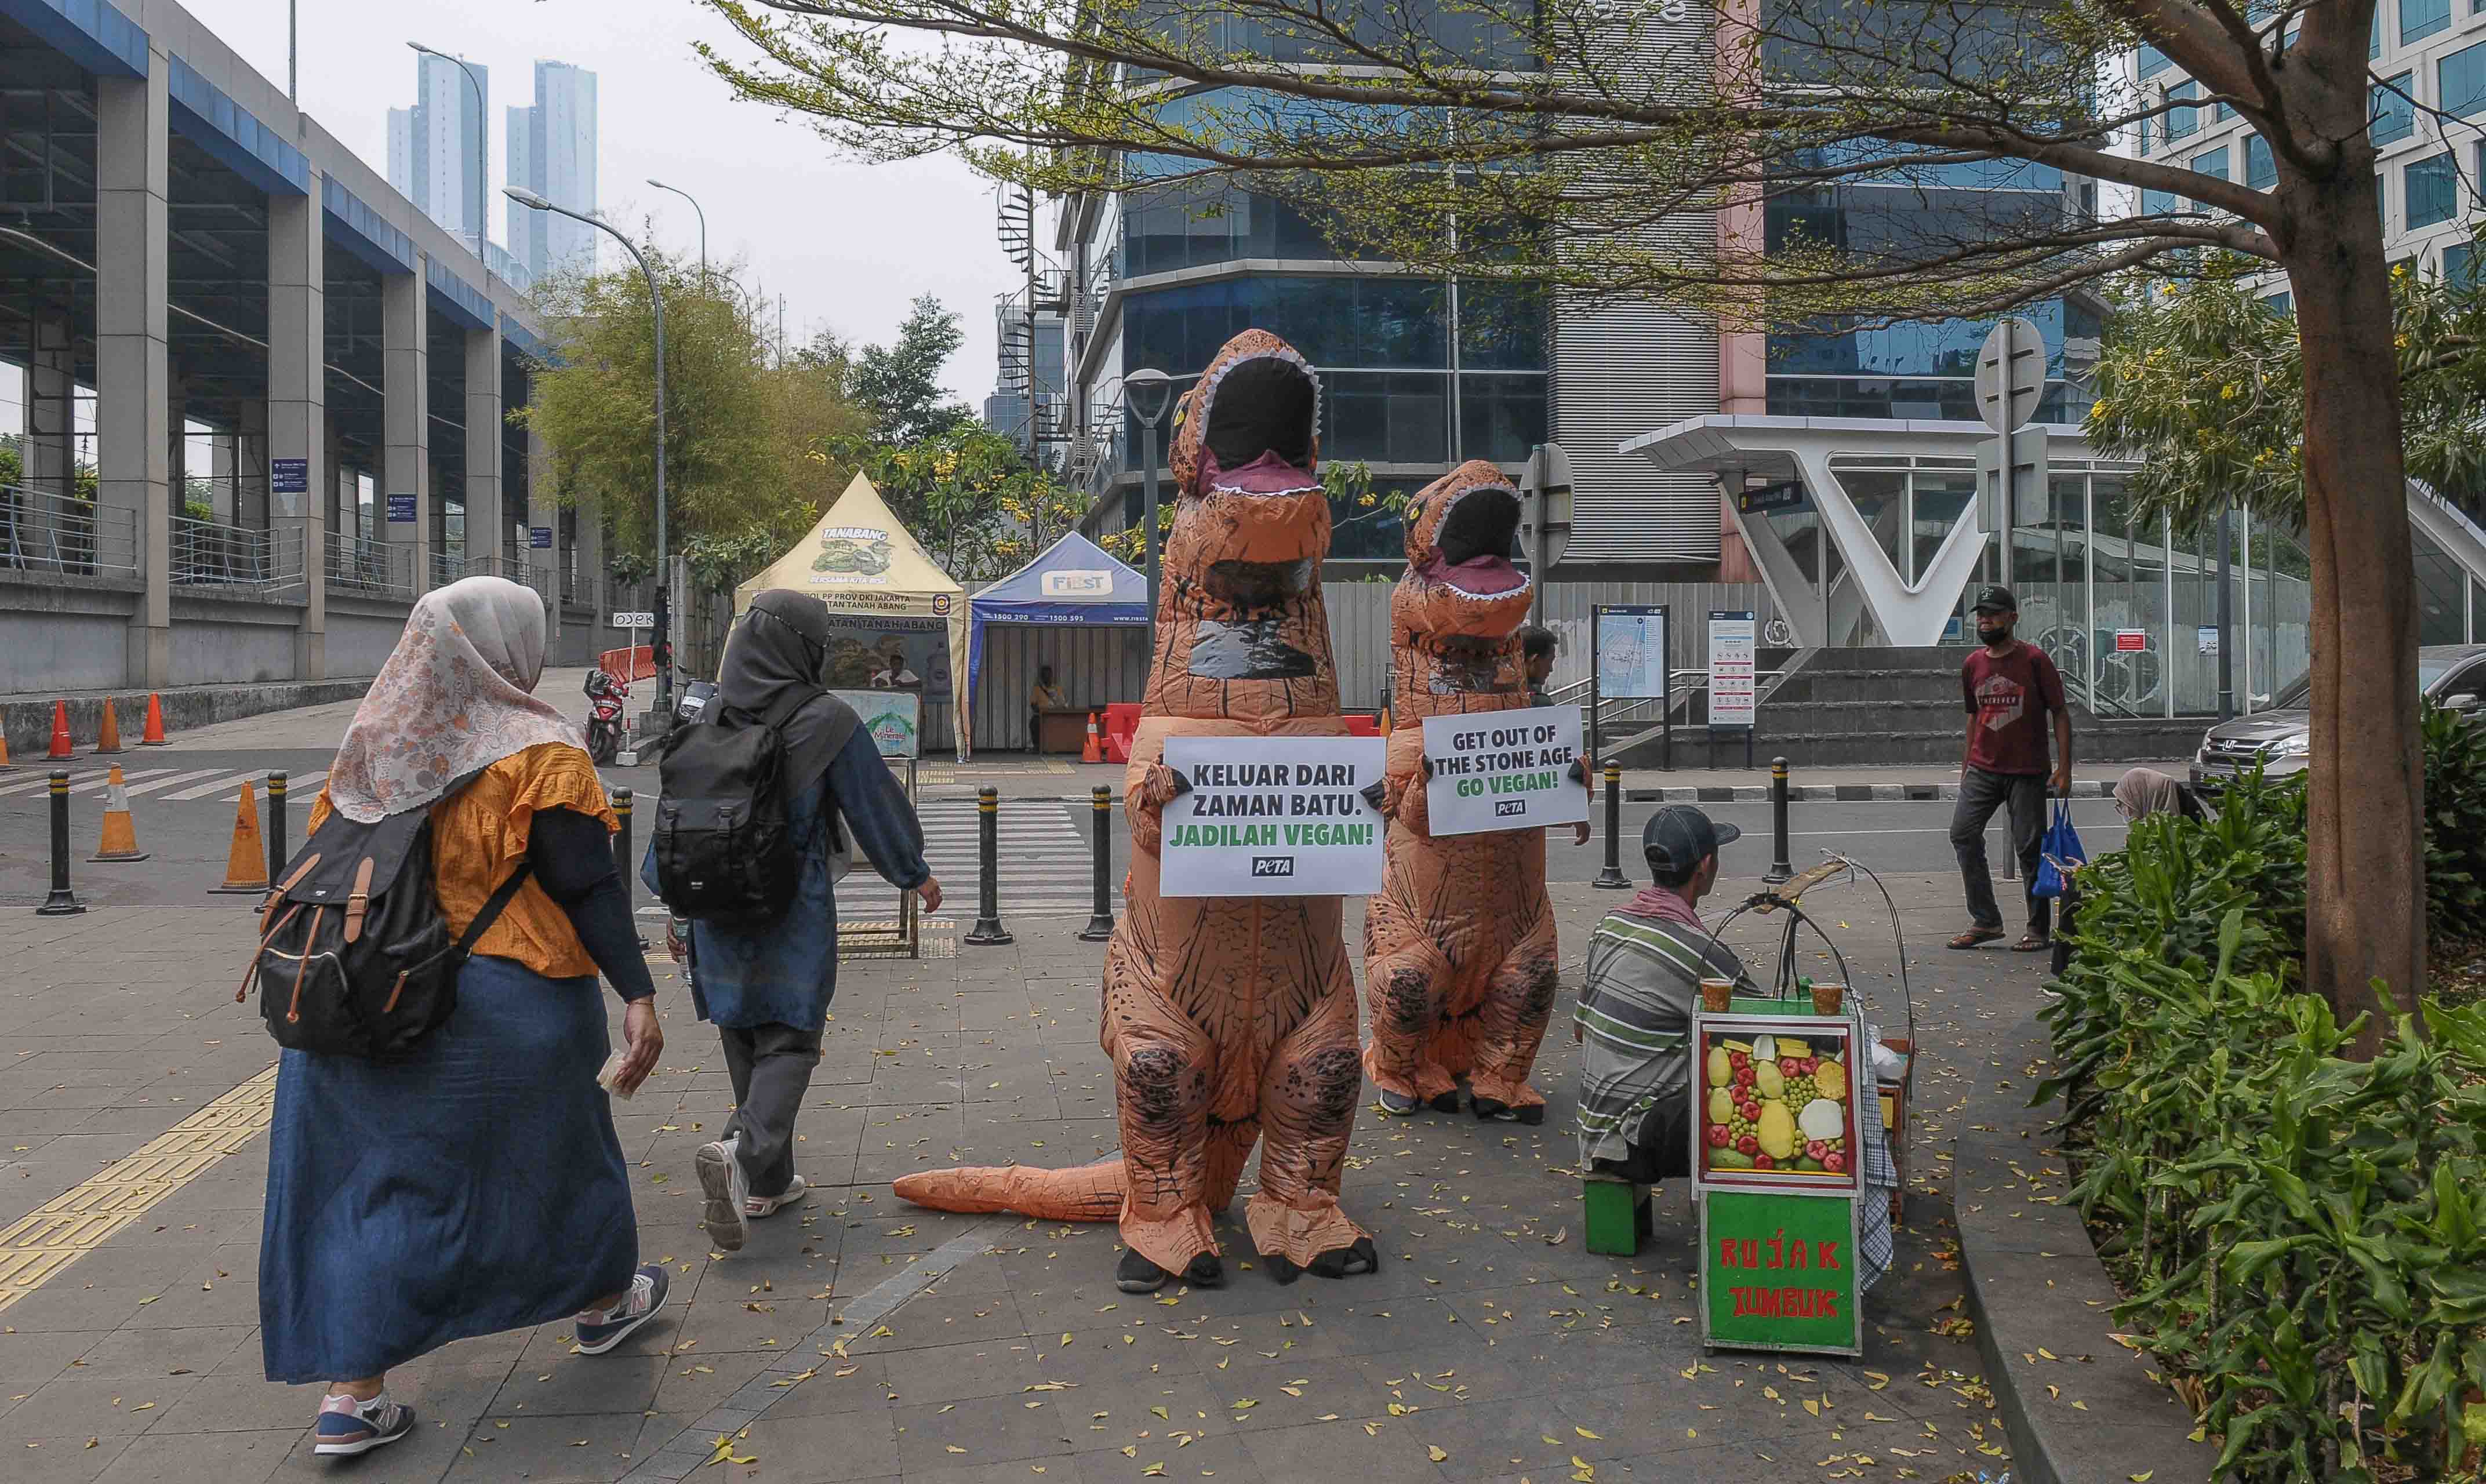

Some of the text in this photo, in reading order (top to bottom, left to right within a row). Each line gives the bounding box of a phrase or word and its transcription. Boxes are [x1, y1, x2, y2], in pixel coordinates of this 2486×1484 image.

[822, 528, 888, 541] TANABANG
[874, 594, 911, 603] JAKARTA
[860, 620, 900, 629] TANAH
[903, 621, 943, 631] ABANG
[1453, 725, 1556, 751] GET OUT OF
[1435, 756, 1471, 776] THE
[1475, 750, 1535, 773] STONE
[1193, 765, 1355, 787] KELUAR DARI
[1456, 770, 1558, 798] GO VEGAN!
[1193, 794, 1362, 816] ZAMAN BATU.
[1169, 824, 1373, 847] JADILAH VEGAN!
[1729, 1286, 1838, 1318] TUMBUK
